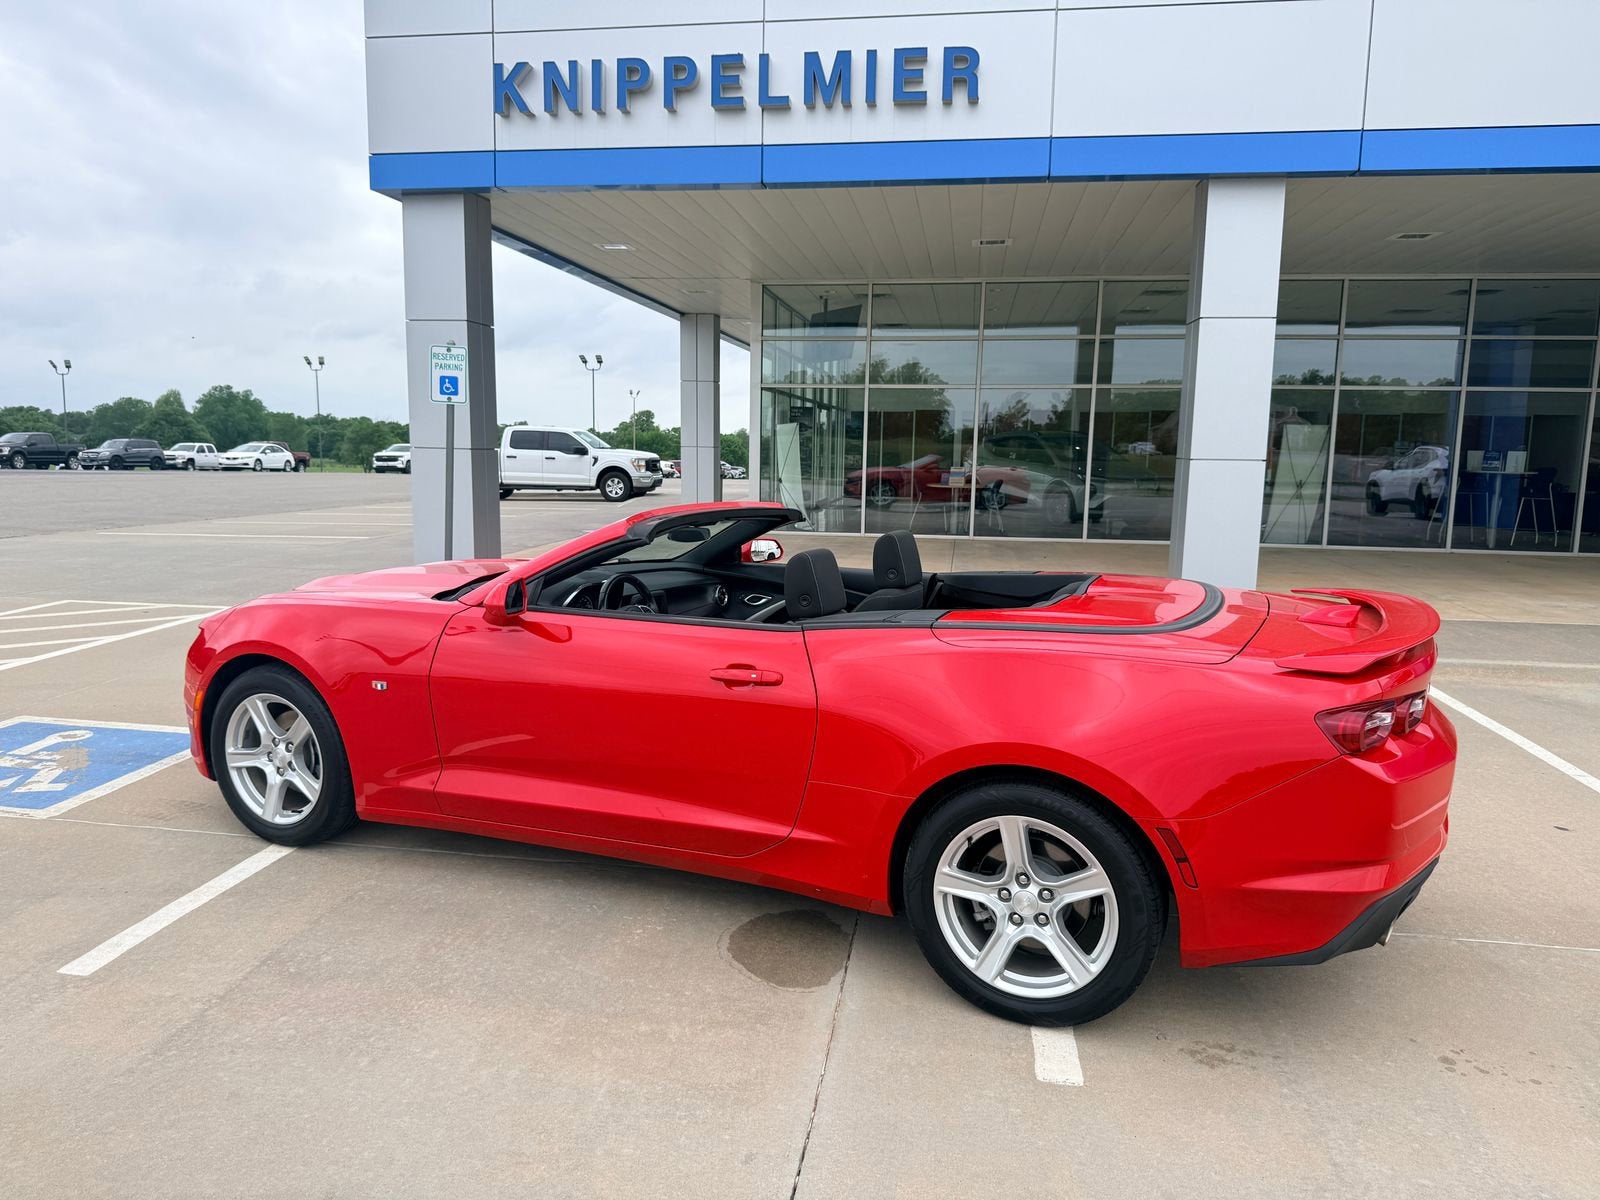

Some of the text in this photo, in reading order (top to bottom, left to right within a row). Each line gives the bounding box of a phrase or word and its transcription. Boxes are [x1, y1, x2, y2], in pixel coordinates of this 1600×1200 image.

[494, 46, 981, 117] KNIPPELMIER
[432, 352, 465, 361] RESERVED
[434, 362, 463, 371] PARKING
